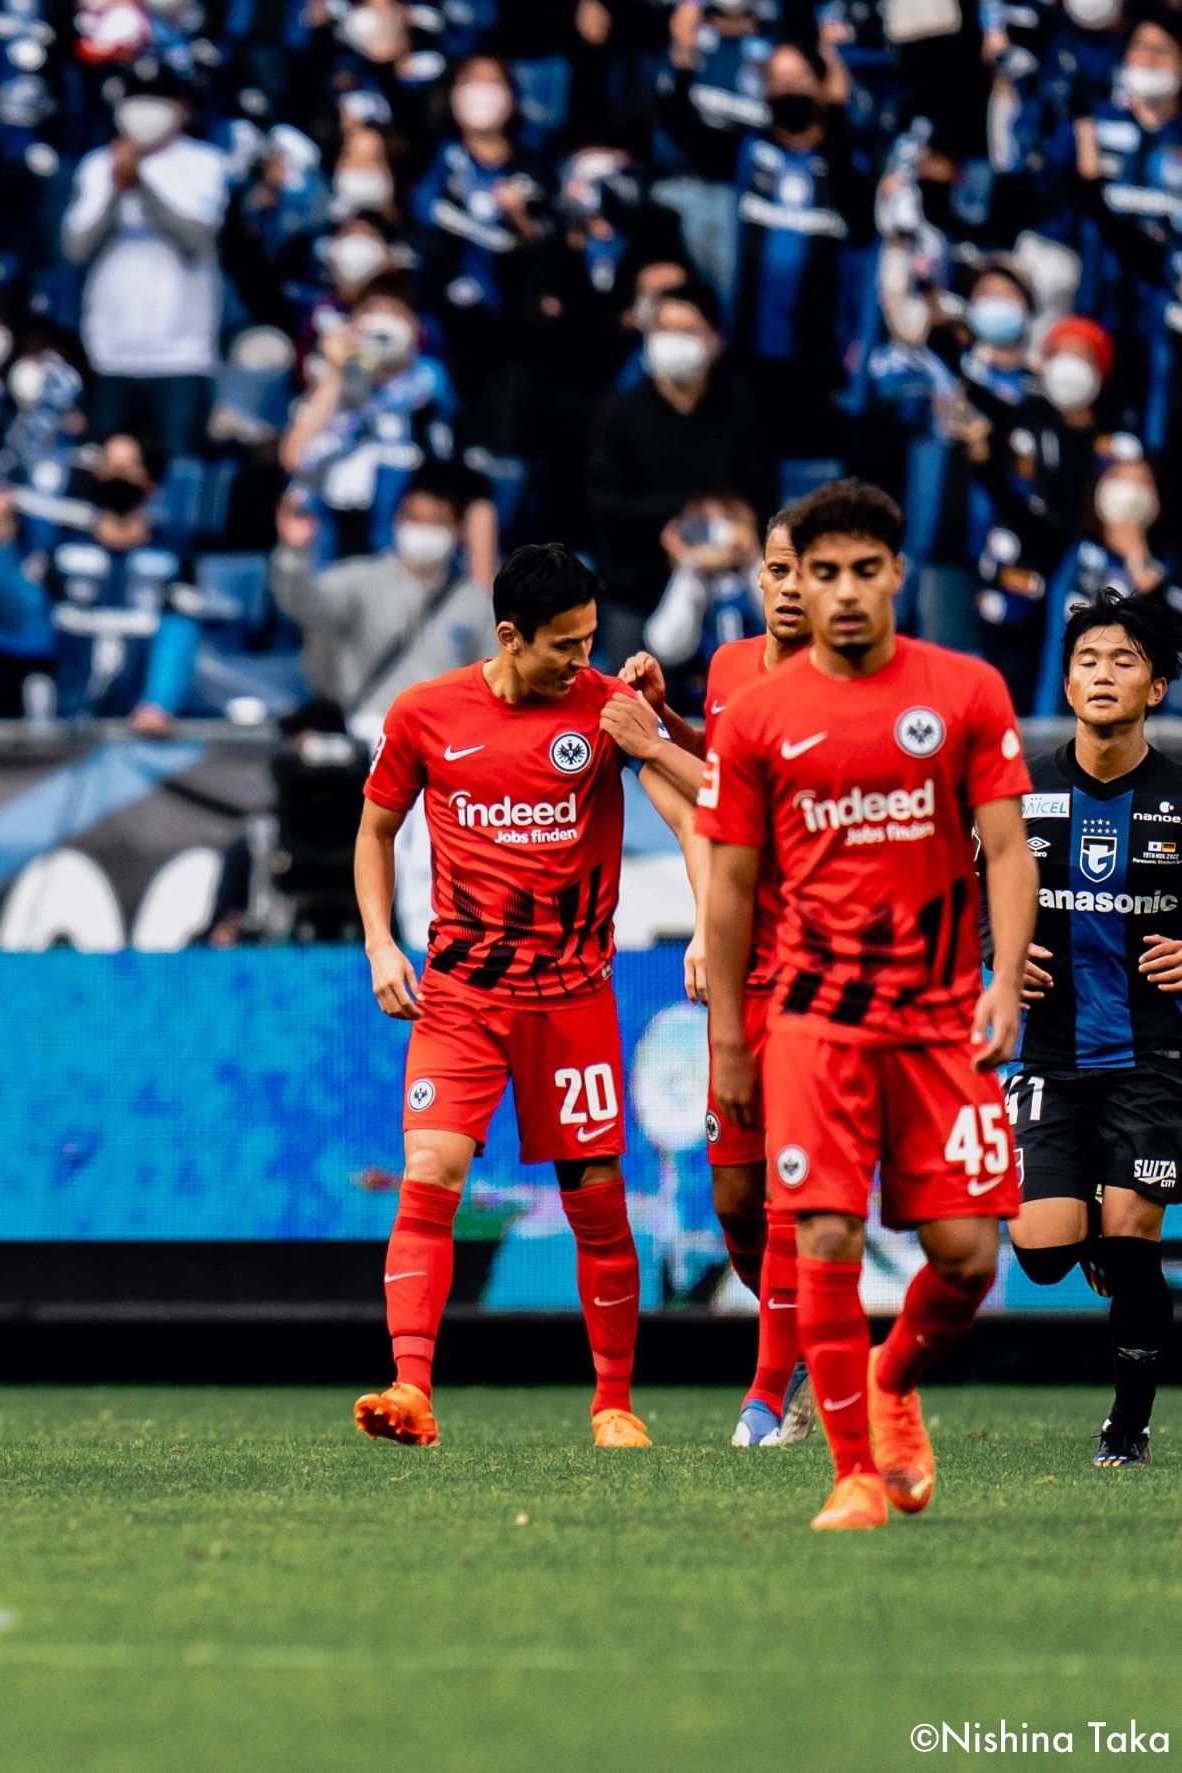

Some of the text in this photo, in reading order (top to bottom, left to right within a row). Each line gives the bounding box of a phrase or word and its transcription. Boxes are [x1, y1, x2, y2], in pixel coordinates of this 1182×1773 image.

[448, 791, 577, 827] indeed
[793, 778, 935, 832] indeed
[1133, 812, 1182, 824] nanoe
[494, 827, 577, 844] Jobs finden
[1038, 888, 1178, 914] anasonic
[554, 1063, 618, 1124] 20
[944, 1103, 1010, 1176] 45
[1133, 1159, 1177, 1184] SUITA
[1161, 1179, 1176, 1188] CITY
